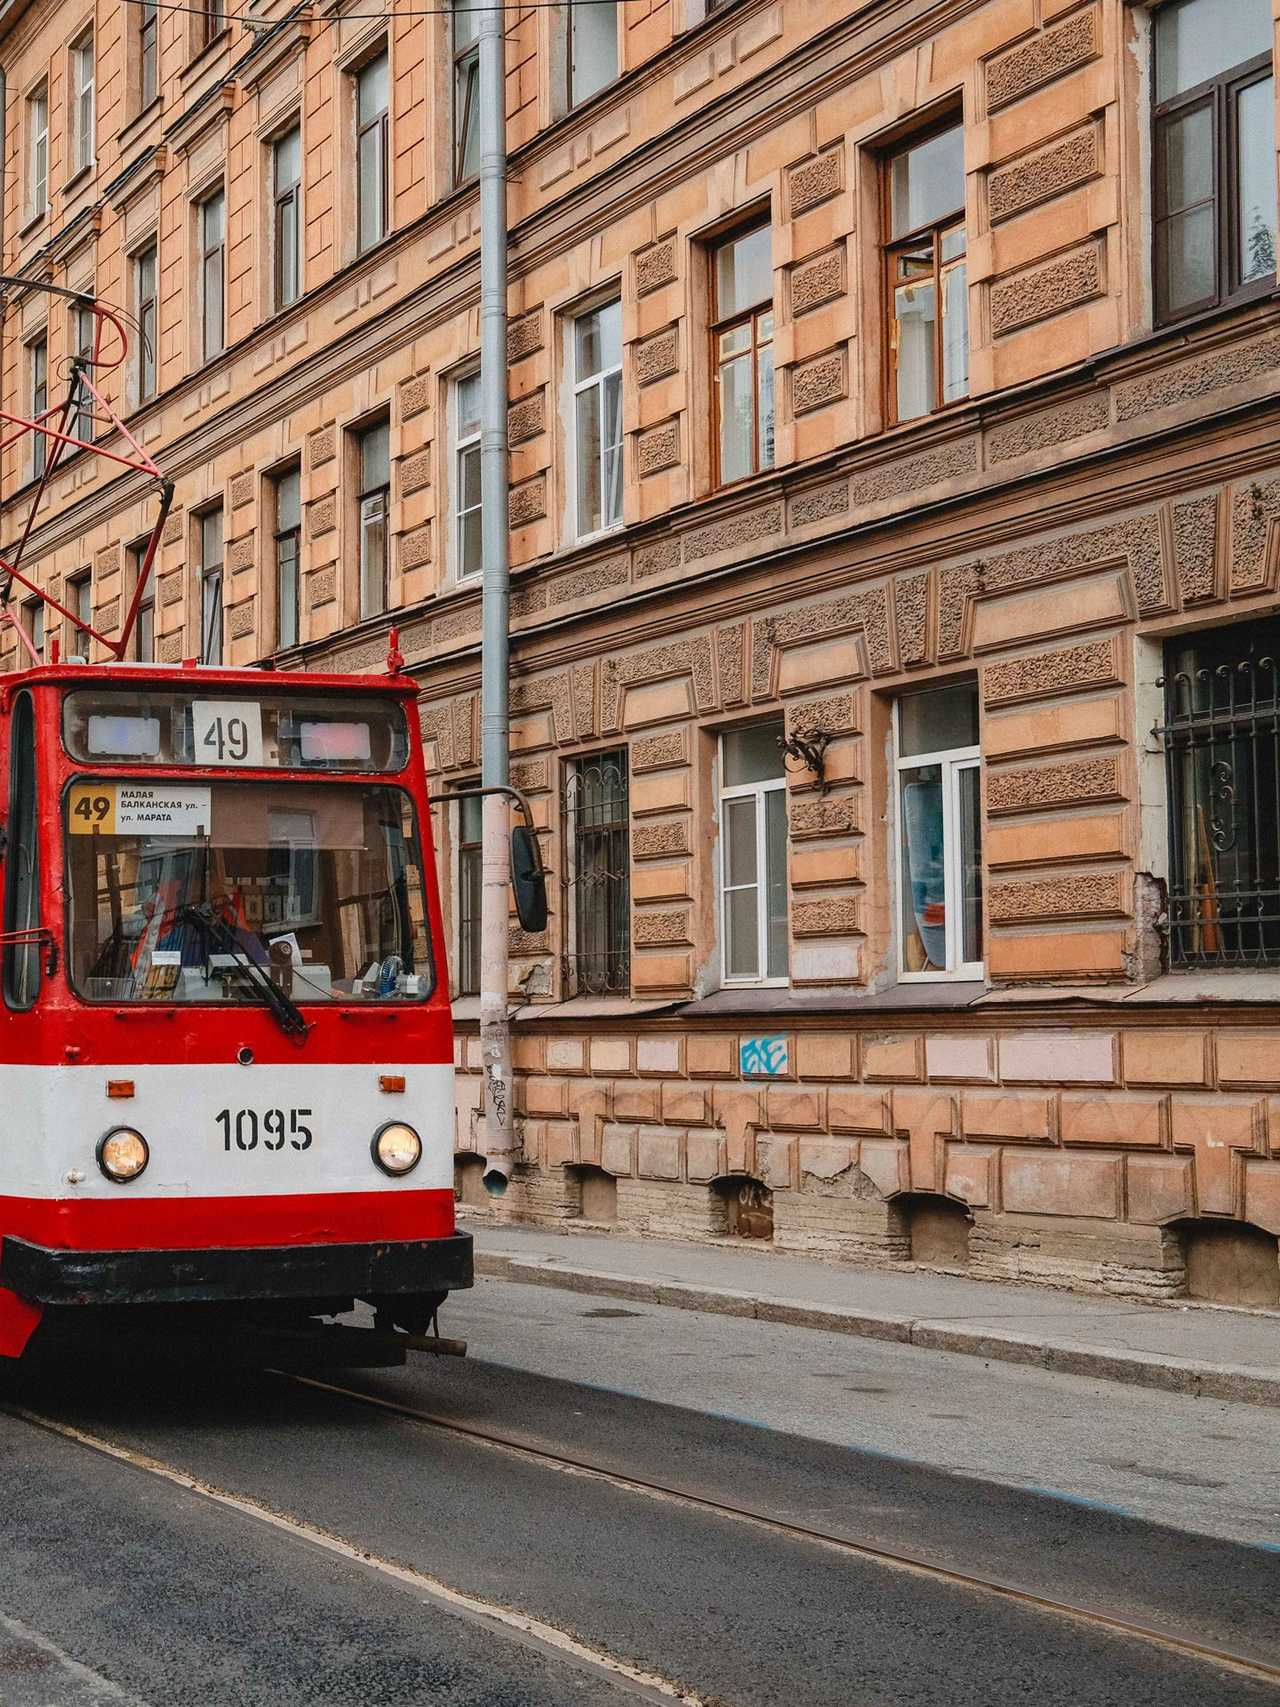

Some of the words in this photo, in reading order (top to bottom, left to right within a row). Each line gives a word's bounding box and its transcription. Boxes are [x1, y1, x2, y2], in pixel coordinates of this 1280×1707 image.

[203, 717, 248, 761] 49
[120, 790, 154, 799] МАЛАЯ
[74, 796, 110, 821] 49
[120, 800, 182, 809] БАЛКАНСКАЯ
[185, 802, 198, 811] ул.
[120, 814, 134, 822] ул.
[136, 813, 172, 822] МАРАТА
[215, 1108, 313, 1151] 1095
